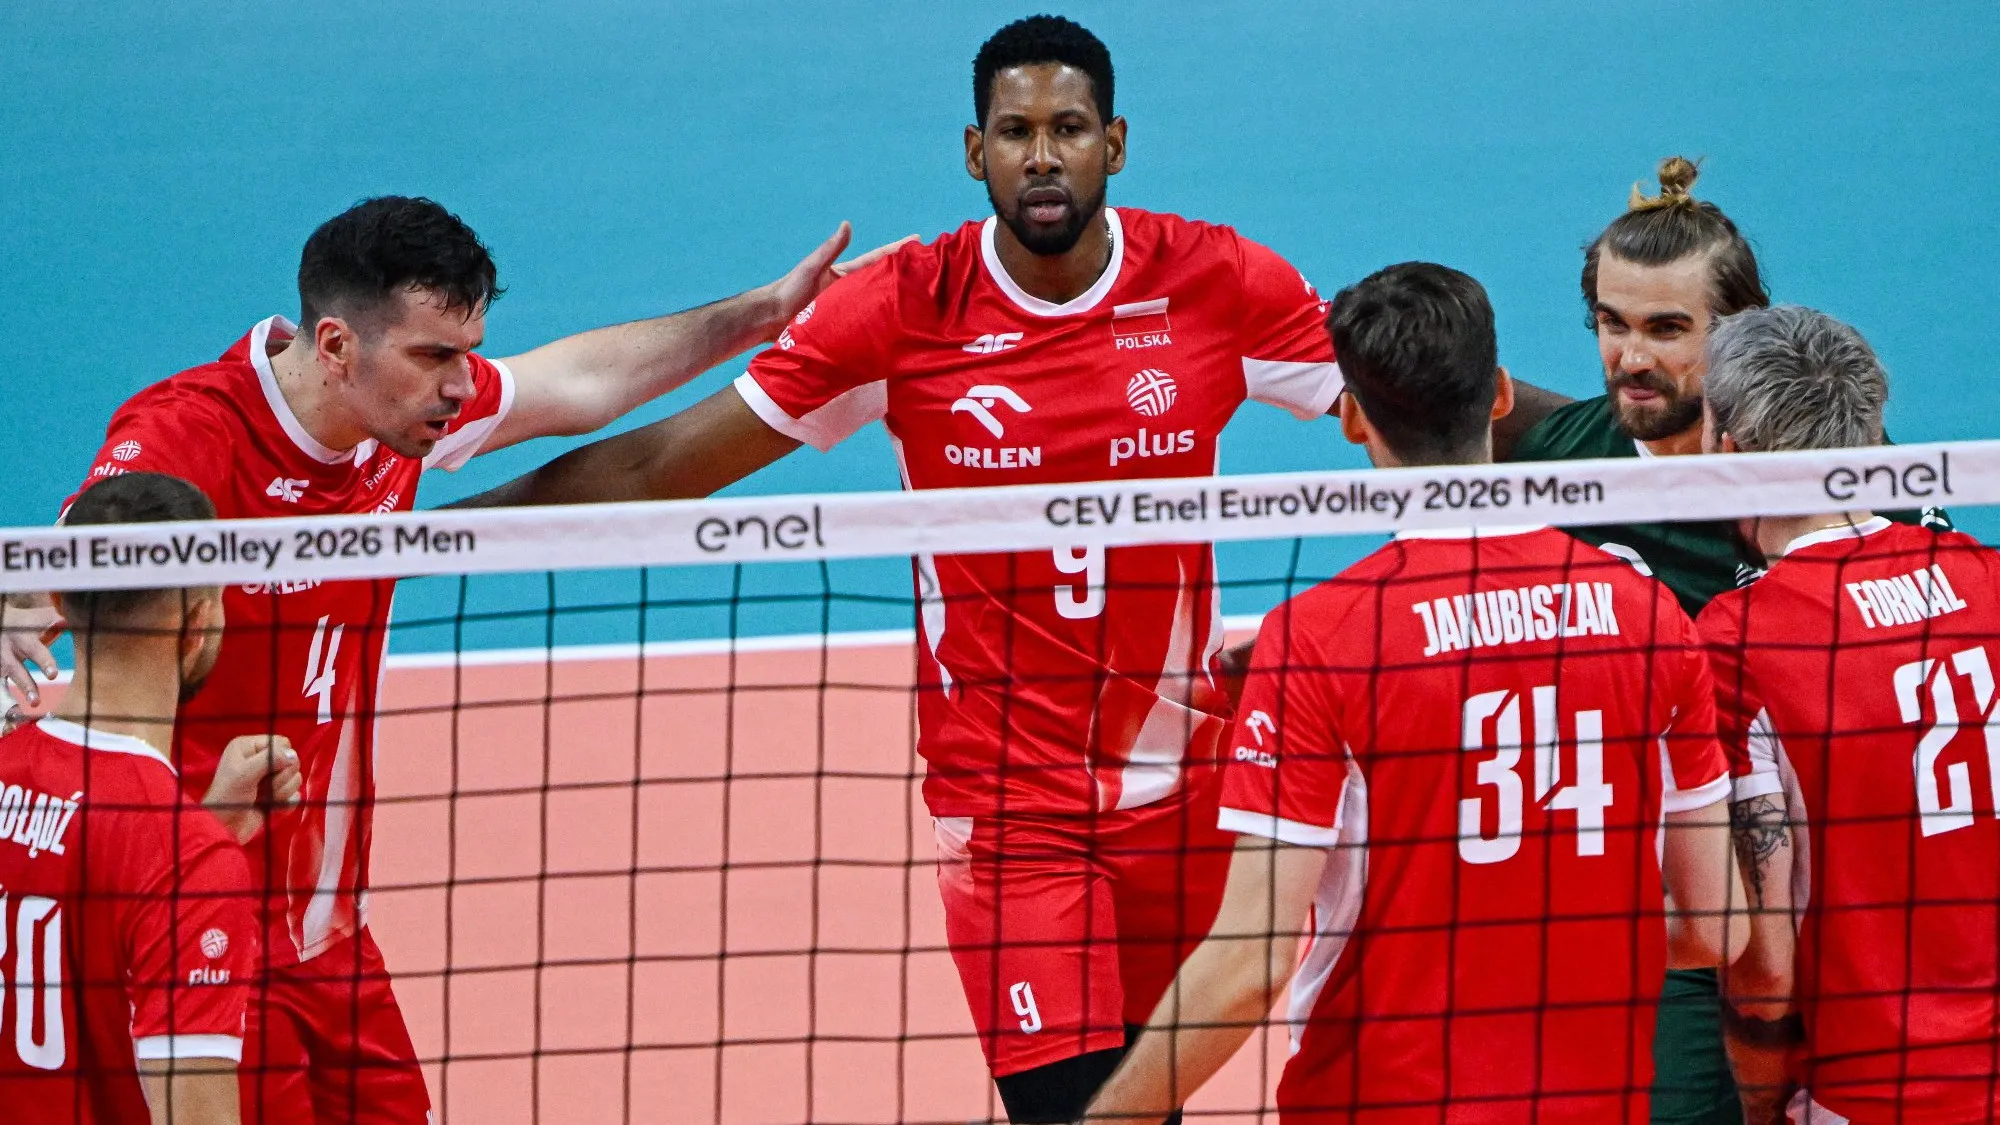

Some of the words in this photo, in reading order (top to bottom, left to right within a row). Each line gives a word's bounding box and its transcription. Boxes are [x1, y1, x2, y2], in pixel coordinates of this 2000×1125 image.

[1115, 333, 1172, 350] POLSKA
[944, 445, 1042, 469] ORLEN
[1109, 428, 1195, 467] plus
[1823, 452, 1953, 501] enel
[695, 503, 824, 553] enel
[1045, 494, 1122, 528] CEV
[1133, 490, 1207, 524] Enel
[1220, 479, 1413, 521] EuroVolley
[1423, 480, 1512, 511] 2026
[1522, 474, 1605, 506] Men
[3, 536, 77, 572] Enel
[90, 530, 283, 570] EuroVolley
[294, 526, 382, 559] 2026
[395, 523, 476, 555] Men
[1052, 543, 1106, 620] 9
[1845, 564, 1968, 629] FORNAL
[1412, 582, 1619, 658] JAKUBISZAK
[301, 613, 346, 725] 4
[1893, 645, 2000, 838] 21
[1458, 685, 1614, 865] 34
[0, 781, 84, 859] OŁĄDŹ
[0, 884, 66, 1070] 0
[1009, 981, 1042, 1034] 9
